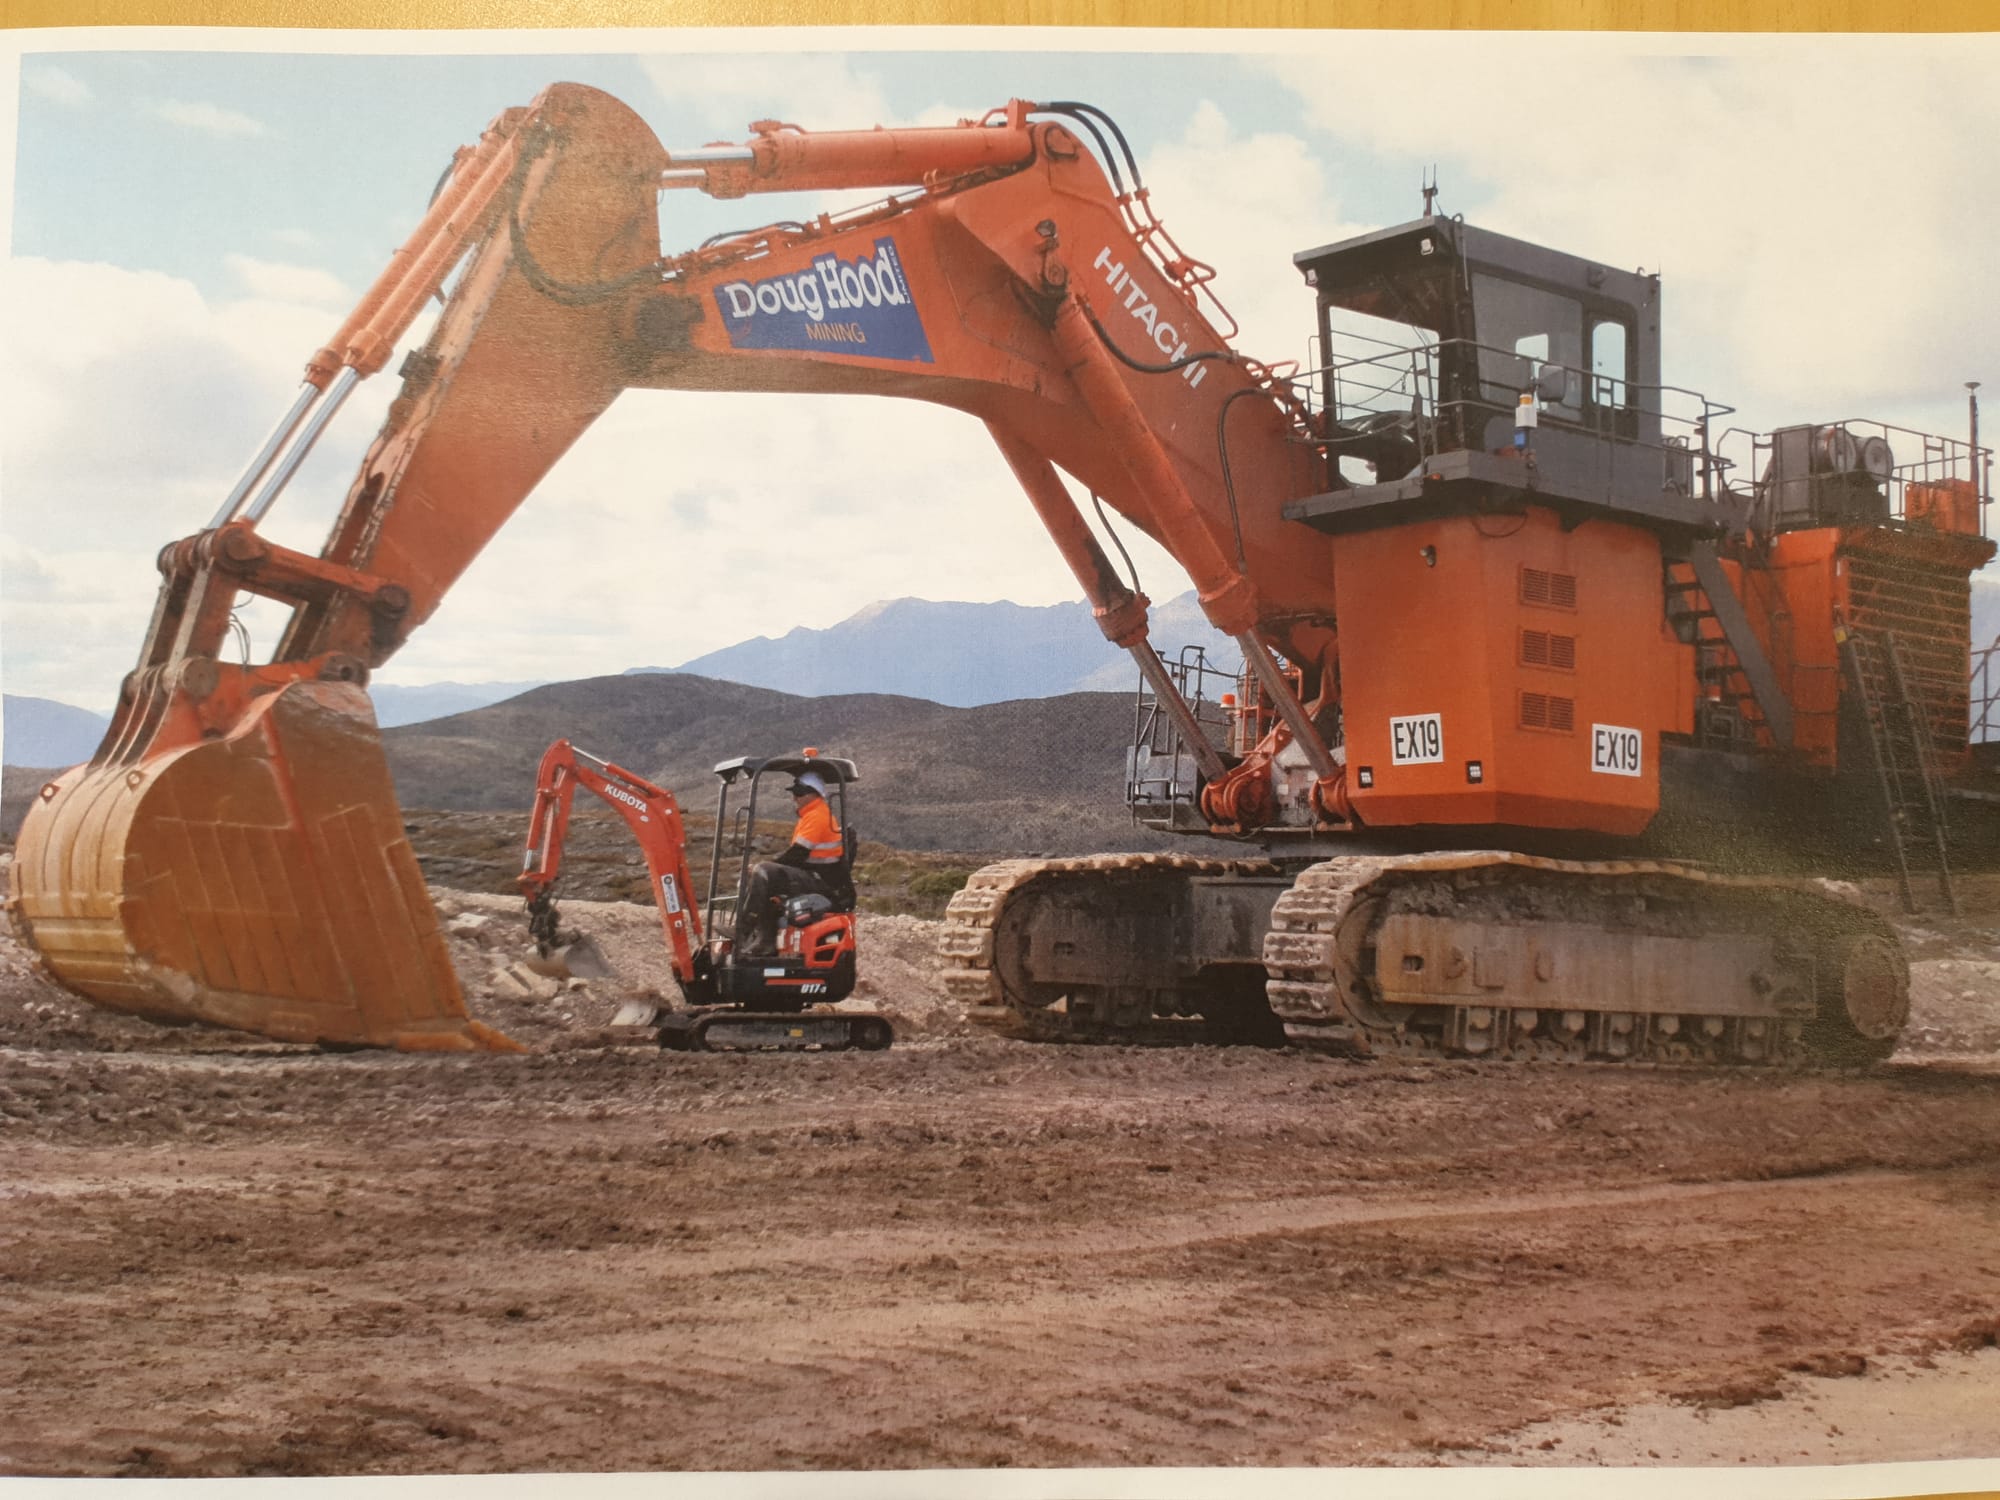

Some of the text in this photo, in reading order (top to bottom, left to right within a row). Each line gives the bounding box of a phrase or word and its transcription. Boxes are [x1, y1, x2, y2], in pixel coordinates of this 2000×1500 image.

[805, 322, 866, 344] MINING
[1093, 246, 1208, 389] HITACHI
[1393, 719, 1440, 759] EX19
[1595, 729, 1638, 771] EX19
[604, 783, 647, 813] KUBOTA
